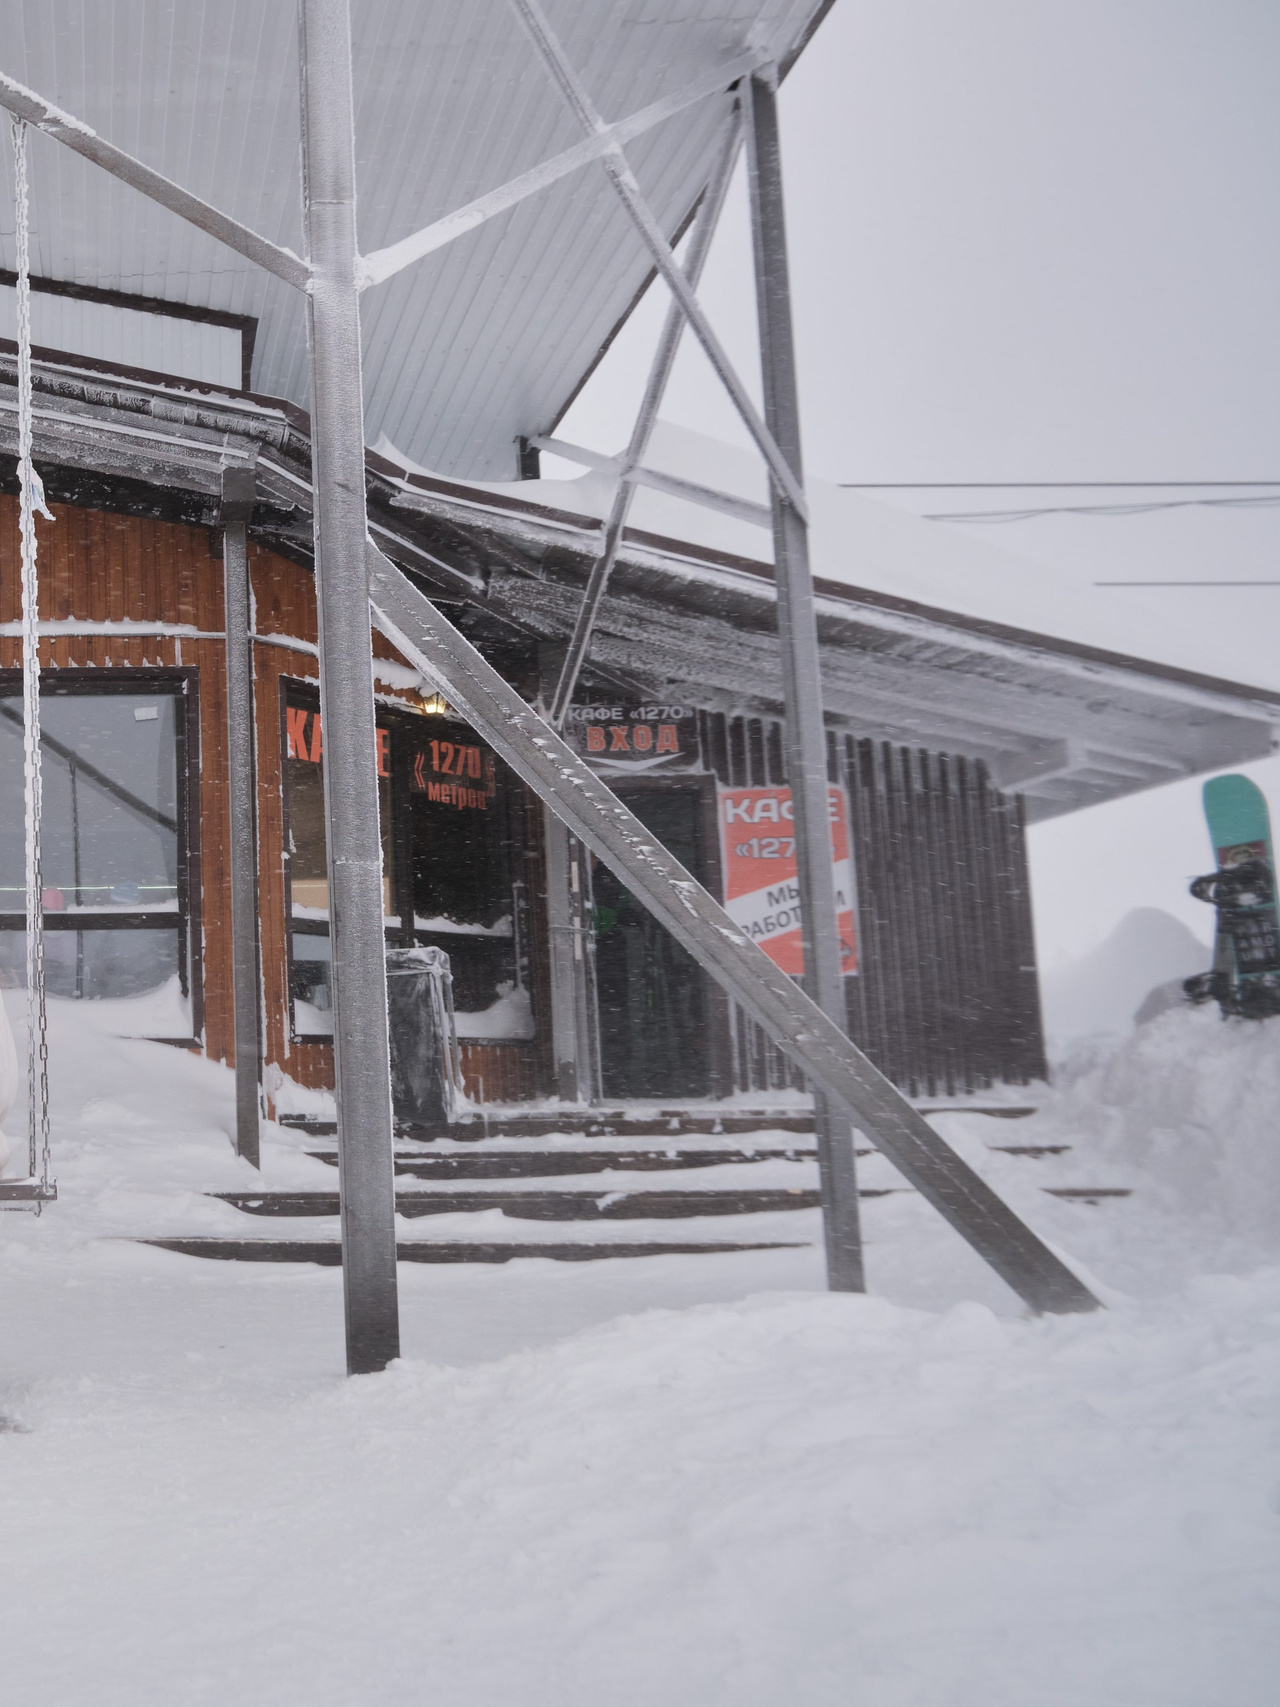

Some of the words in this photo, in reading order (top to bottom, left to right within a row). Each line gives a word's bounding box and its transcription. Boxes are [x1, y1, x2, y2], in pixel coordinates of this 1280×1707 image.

[568, 707, 623, 721] КАФЕ
[286, 707, 390, 778] КАЕ
[586, 724, 679, 753] ВХОД
[725, 798, 840, 823] КАЕ
